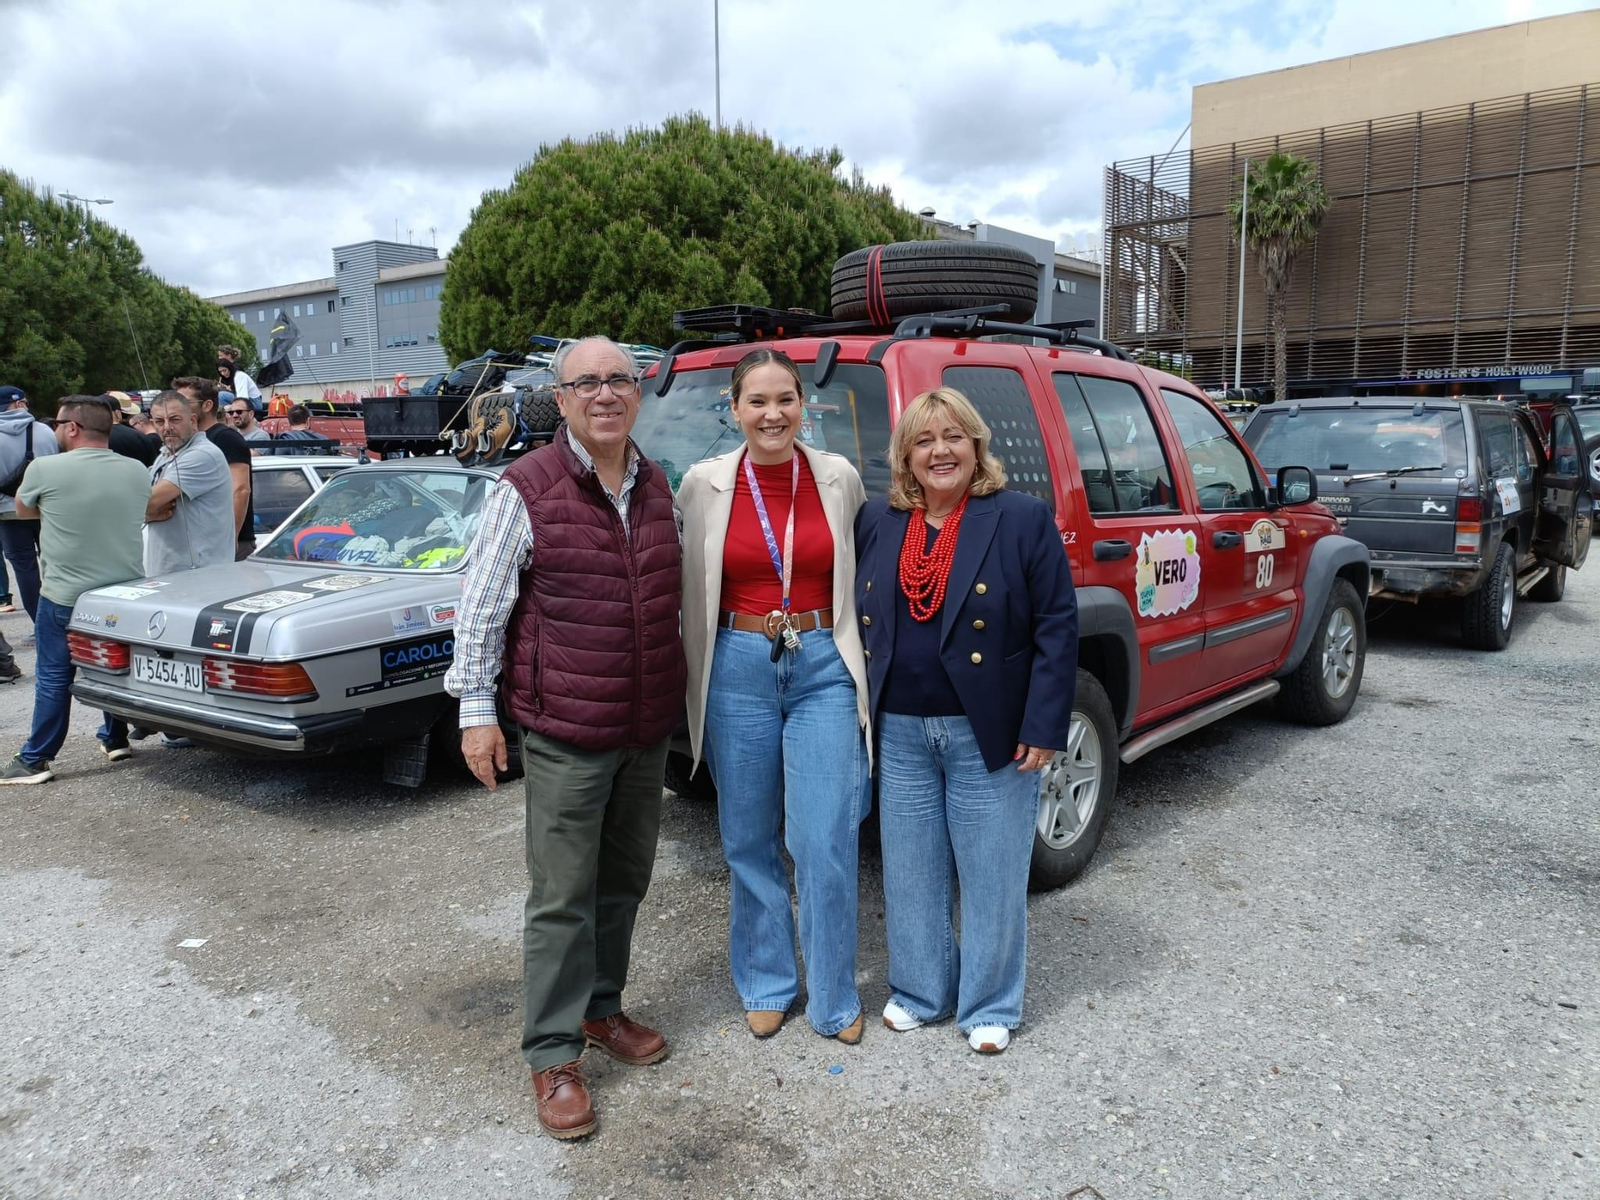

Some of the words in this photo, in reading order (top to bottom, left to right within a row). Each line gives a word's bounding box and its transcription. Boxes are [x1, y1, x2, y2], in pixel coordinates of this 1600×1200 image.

[1416, 368, 1480, 379] FOSTER'S
[1485, 365, 1552, 377] HOLLYWOOD
[1154, 557, 1187, 586] VERO
[1256, 553, 1274, 589] 80
